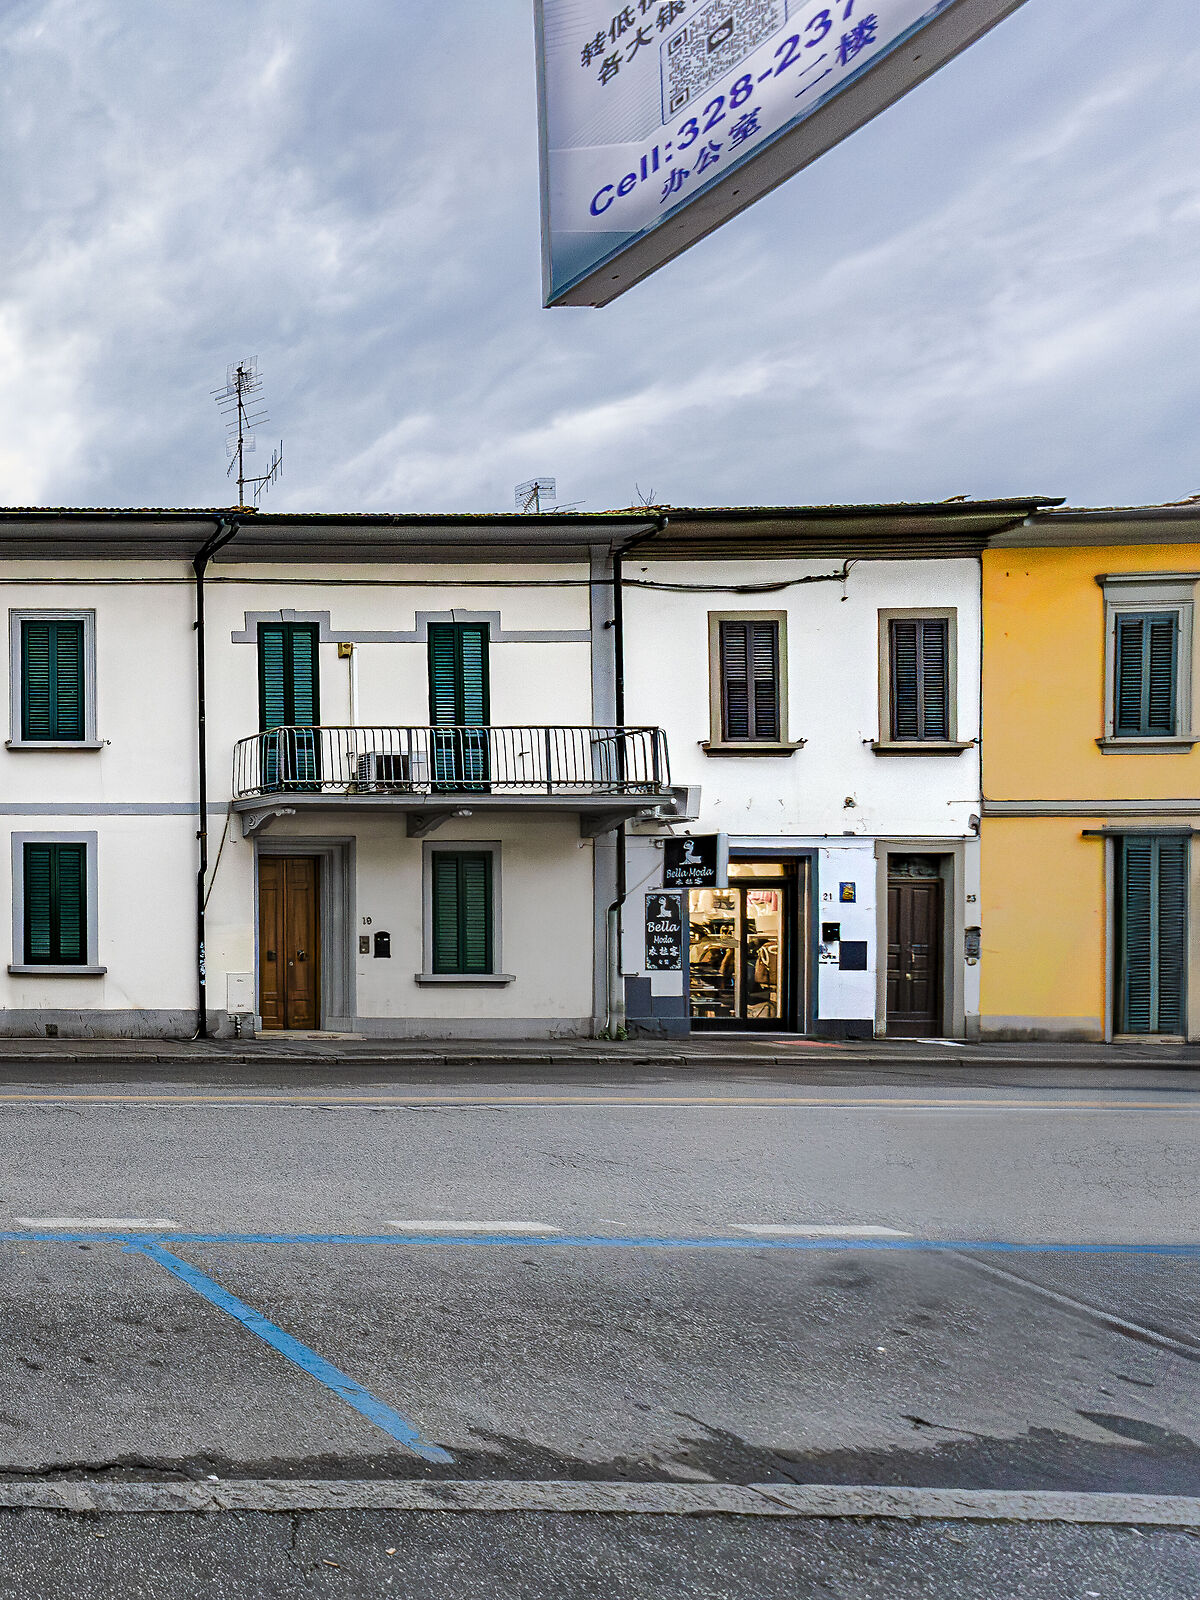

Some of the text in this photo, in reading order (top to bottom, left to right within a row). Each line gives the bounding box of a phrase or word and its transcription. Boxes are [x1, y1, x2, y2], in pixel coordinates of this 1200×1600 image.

[597, 0, 696, 86] 各大银
[659, 13, 878, 204] 办公室 二楼
[666, 866, 714, 878] Bella Moda
[646, 920, 680, 932] Bella
[653, 935, 674, 944] Moda
